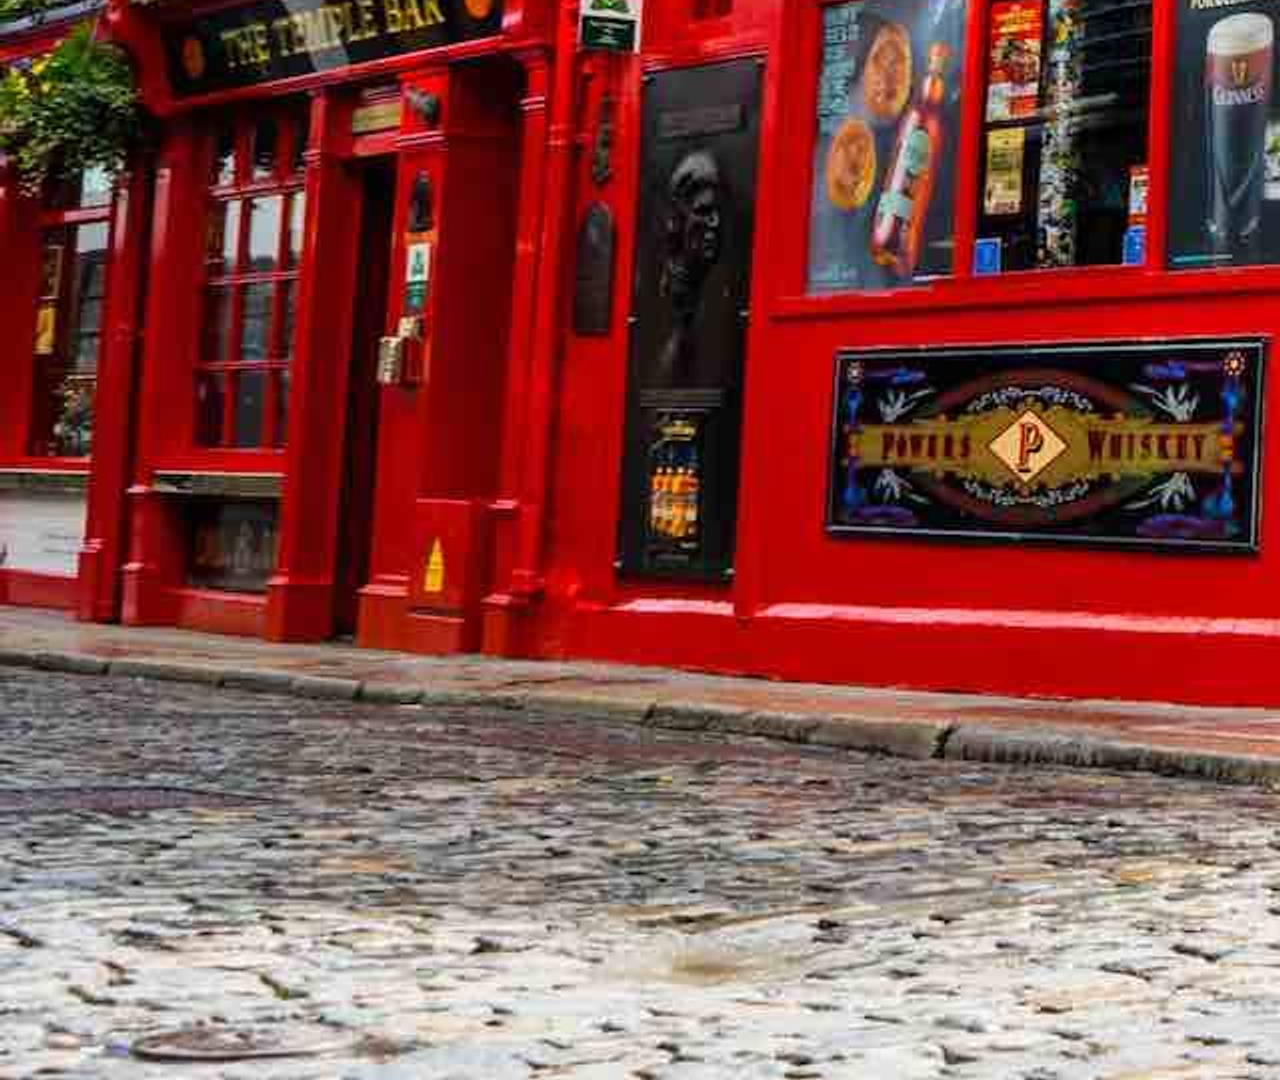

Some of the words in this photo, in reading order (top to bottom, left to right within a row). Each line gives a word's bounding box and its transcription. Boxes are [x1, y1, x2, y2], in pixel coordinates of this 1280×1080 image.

[221, 26, 270, 69] THE
[273, 0, 375, 55] TEMPLE
[880, 431, 971, 460] POWERS
[1086, 428, 1207, 462] WHISKEY
